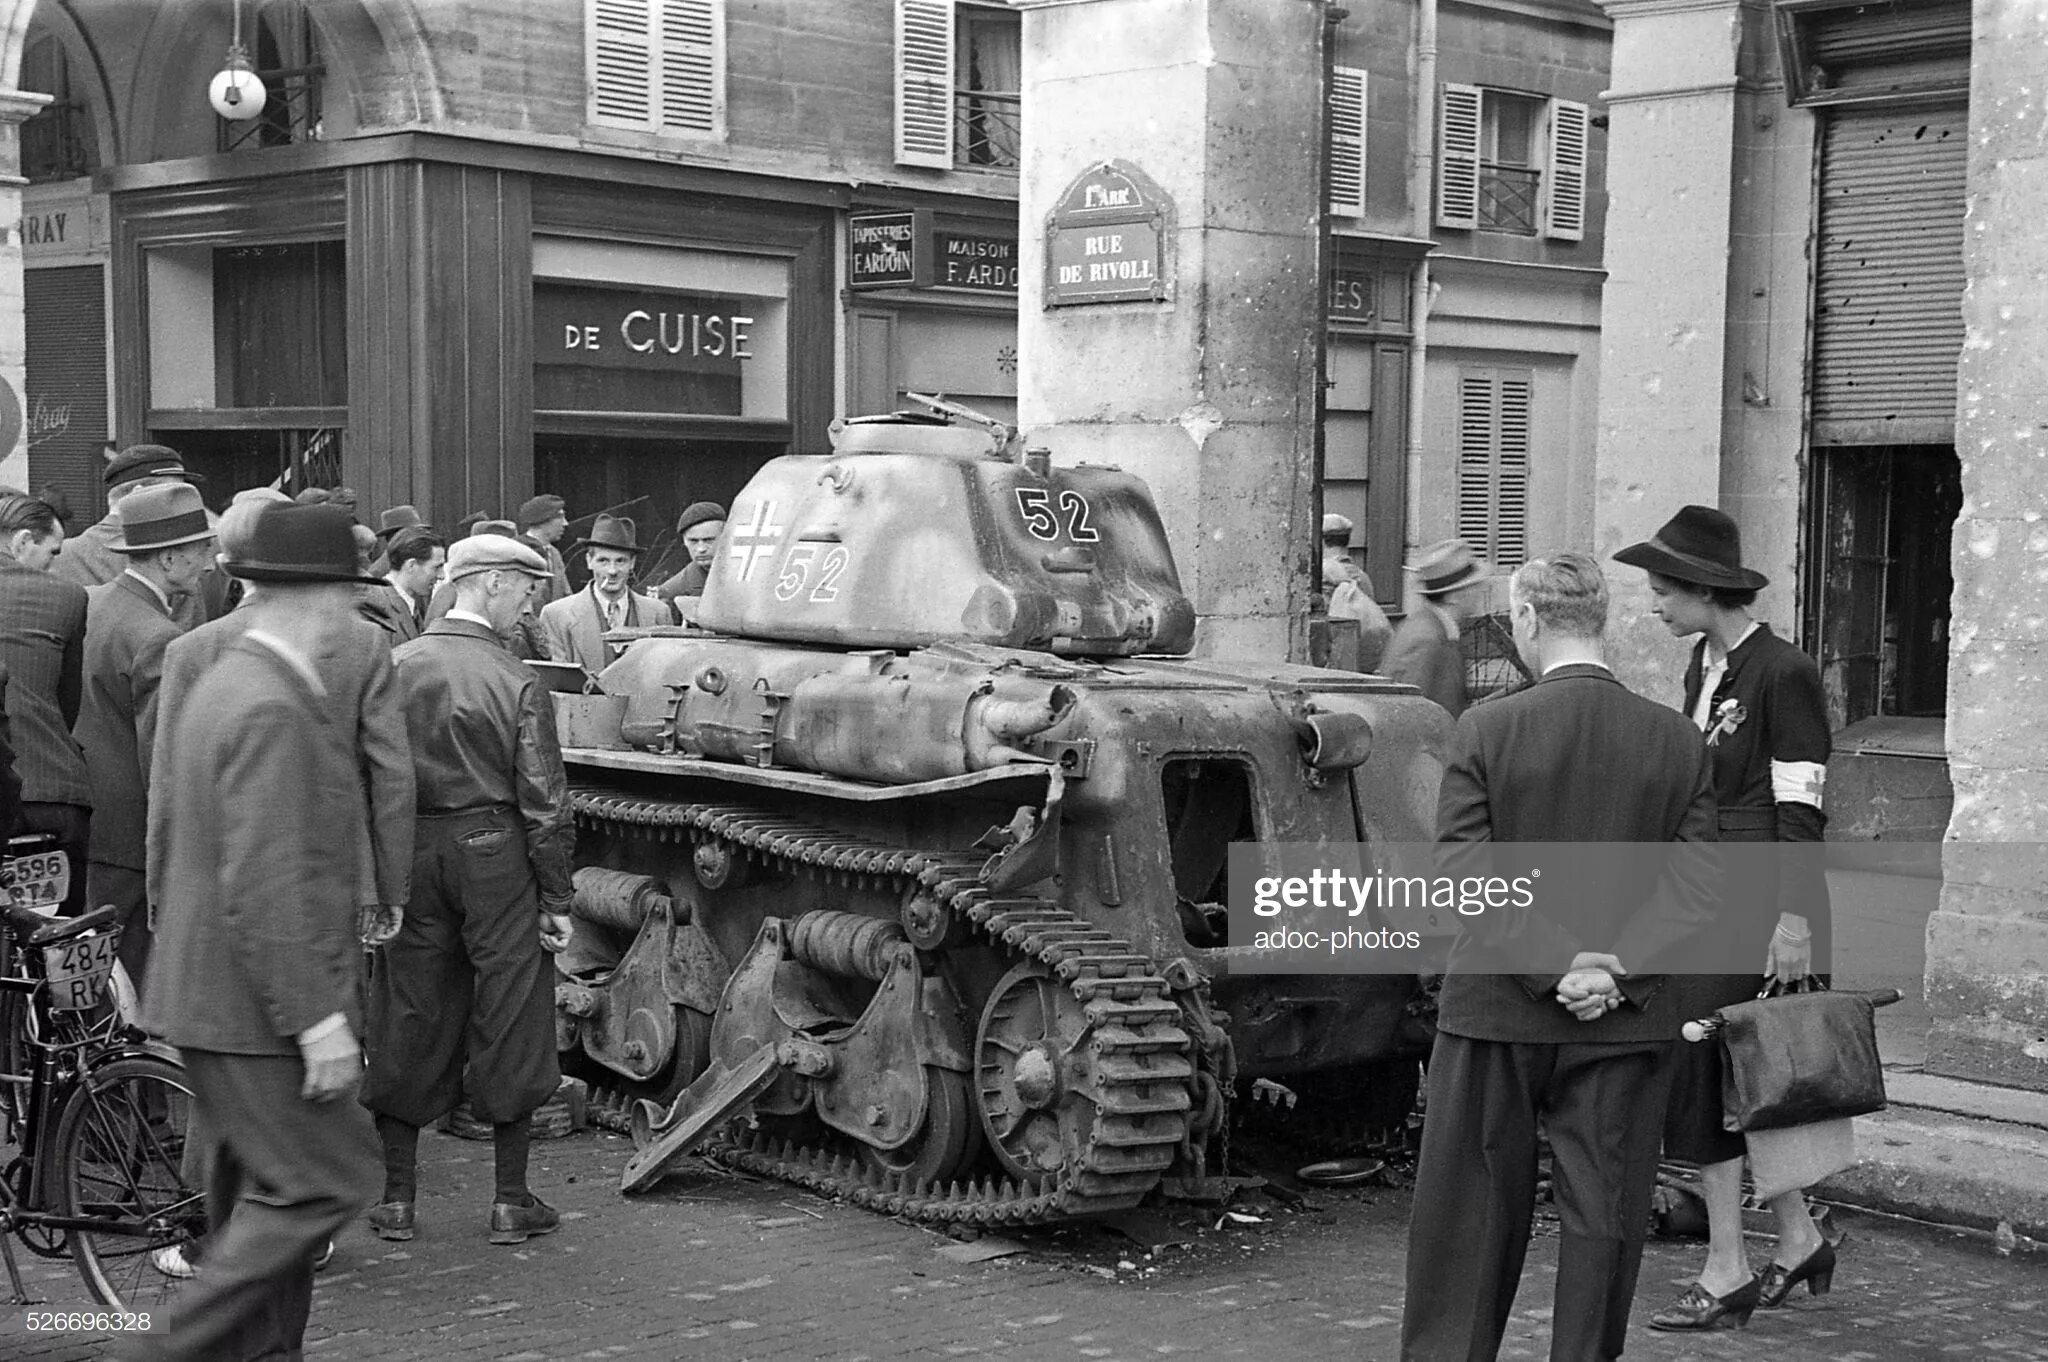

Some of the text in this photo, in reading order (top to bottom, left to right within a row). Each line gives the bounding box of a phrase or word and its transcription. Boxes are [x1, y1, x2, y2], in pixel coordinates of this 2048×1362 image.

[948, 241, 1009, 258] MAISON
[1085, 235, 1122, 255] RUE
[947, 261, 962, 282] F.
[1060, 264, 1082, 284] DE
[1328, 281, 1361, 309] ES
[565, 310, 754, 359] DE GUISE
[1015, 487, 1099, 542] 52
[774, 546, 850, 602] 52
[71, 976, 102, 1008] RK
